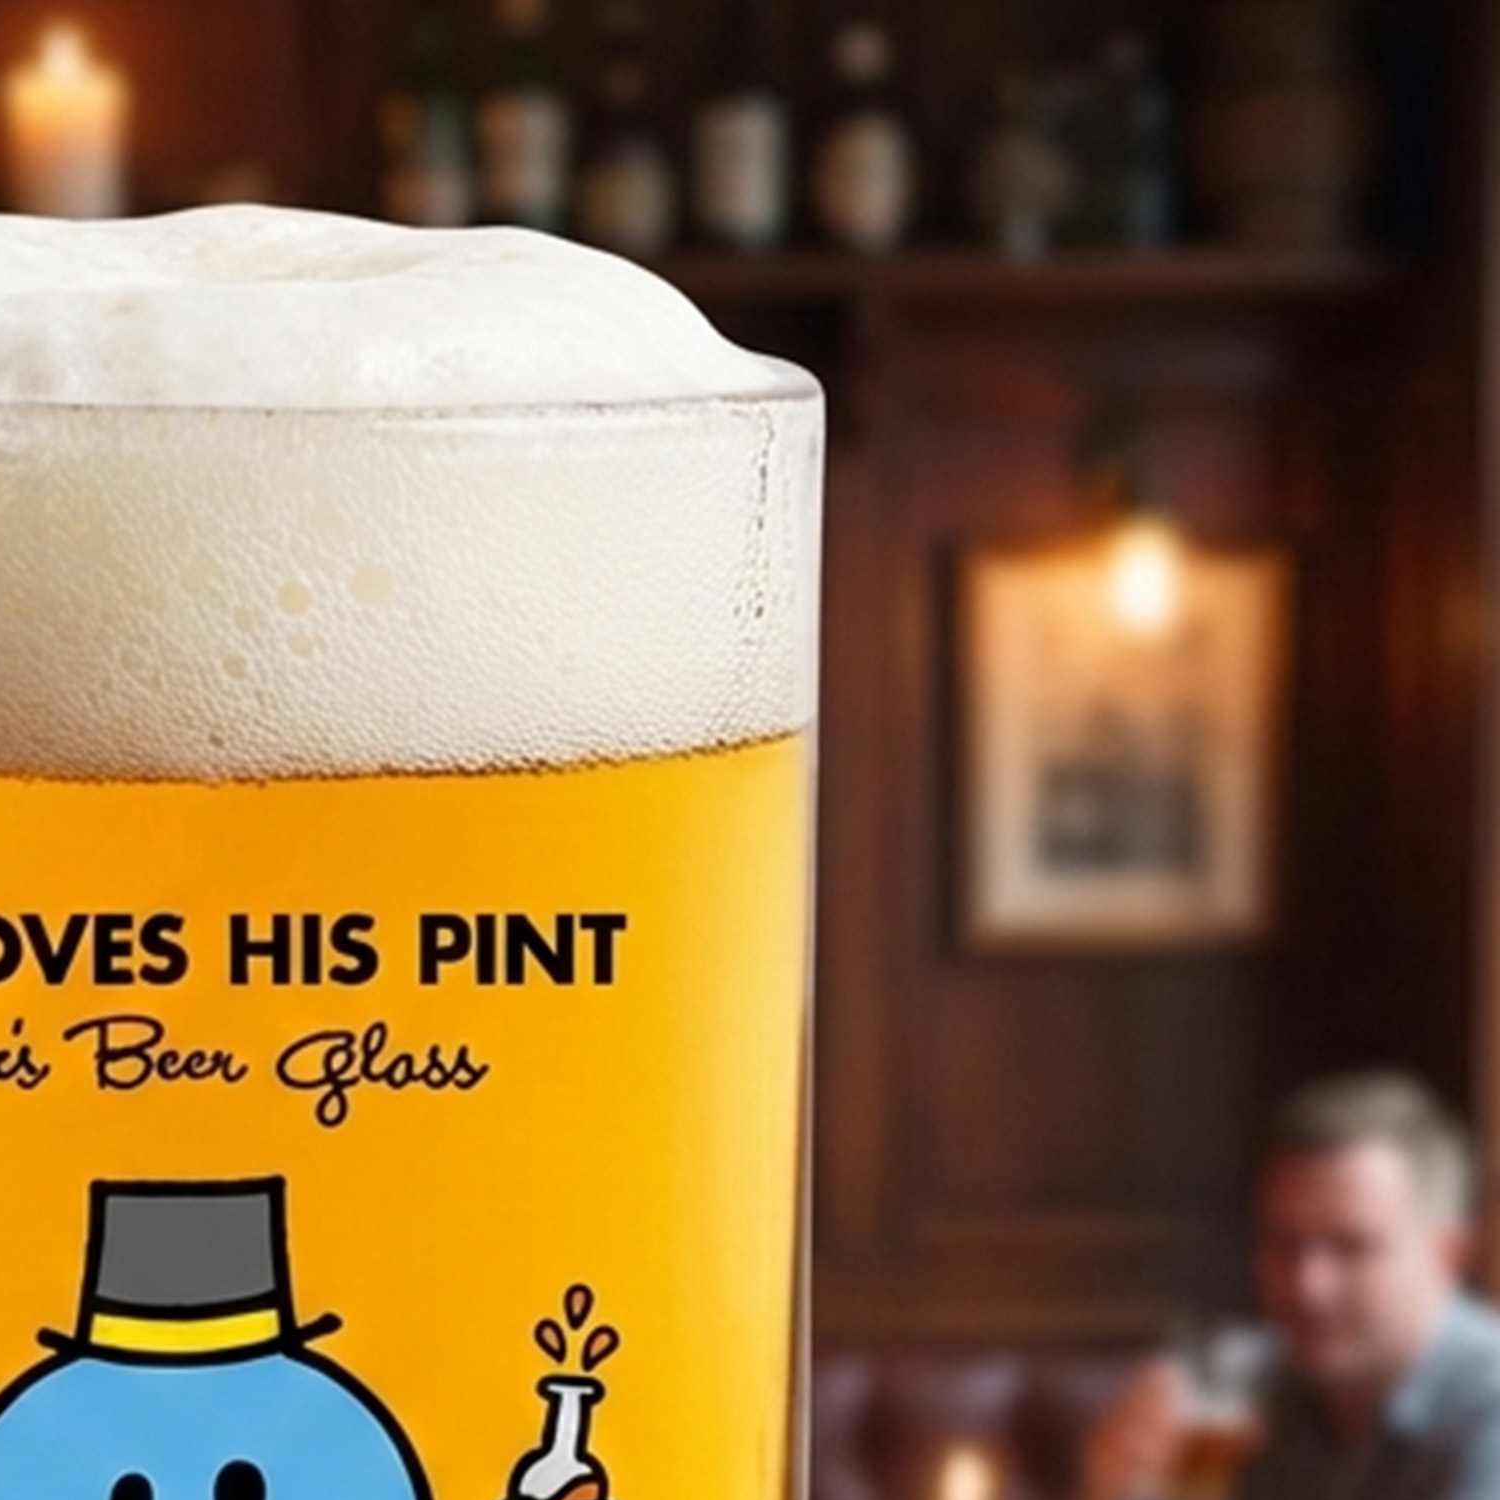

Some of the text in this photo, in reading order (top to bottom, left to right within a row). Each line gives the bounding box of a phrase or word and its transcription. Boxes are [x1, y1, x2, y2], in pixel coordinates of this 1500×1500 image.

[229, 912, 380, 987] HIS
[419, 912, 627, 987] PINT
[62, 1014, 249, 1091] Beer
[275, 1021, 489, 1128] Glass
